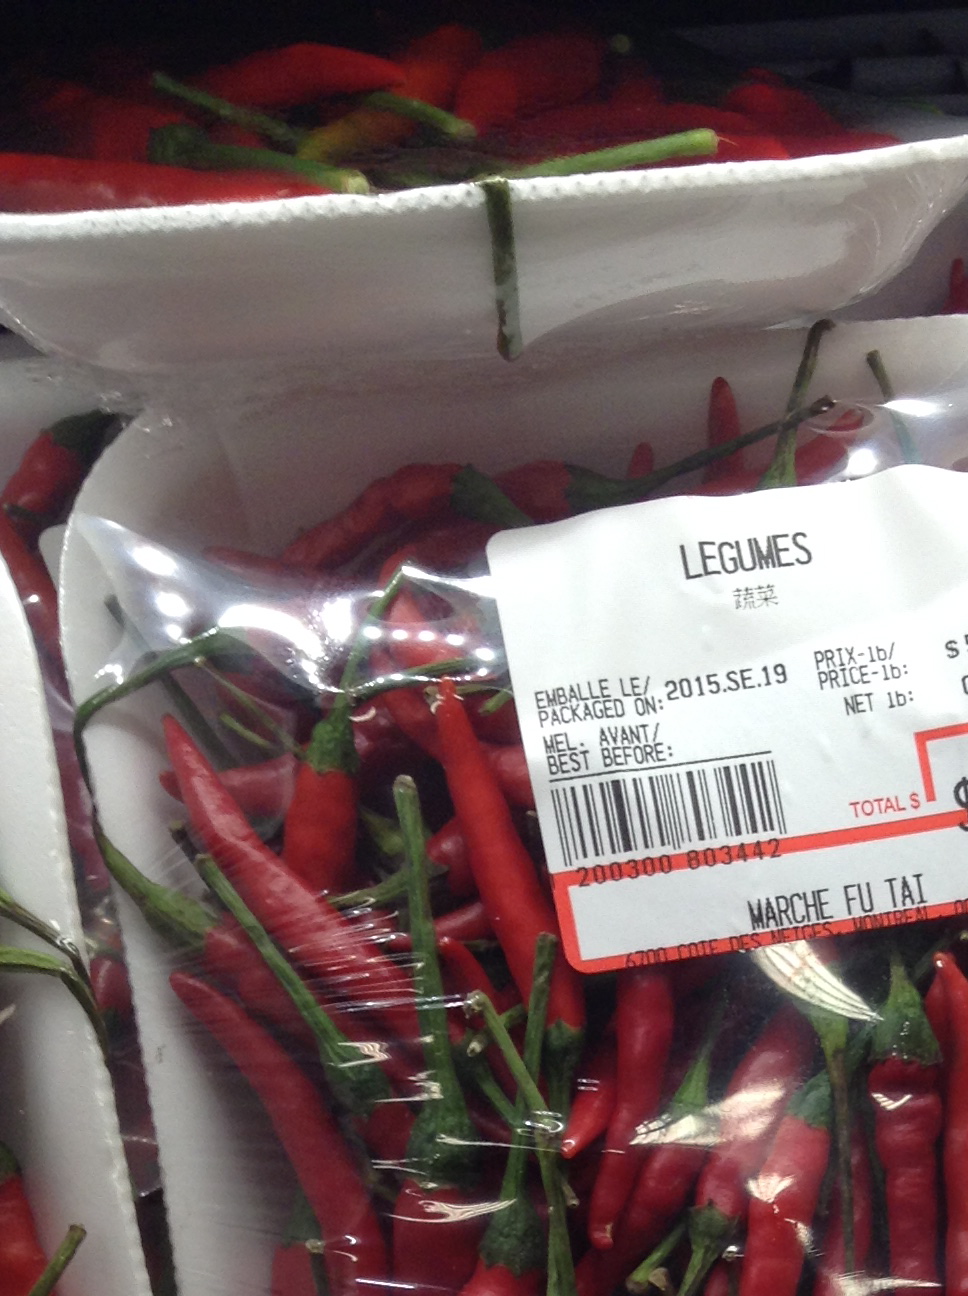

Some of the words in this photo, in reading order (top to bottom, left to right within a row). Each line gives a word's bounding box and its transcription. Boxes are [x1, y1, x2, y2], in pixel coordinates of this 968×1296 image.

[679, 532, 813, 580] LEGUMES
[732, 584, 779, 610] 蔬菜
[534, 678, 611, 710] EMBALLE
[619, 676, 650, 697] LE/
[664, 663, 788, 701] 2015.SE.19
[538, 698, 626, 728] PACKAGED
[634, 696, 664, 717] ON:
[844, 692, 874, 716] NET
[543, 732, 586, 754] MEL.
[599, 722, 660, 747] AVANT/
[546, 749, 590, 776] BEST
[602, 742, 674, 769] BEFORE:
[849, 796, 906, 818] TOTAL
[576, 854, 673, 888] 200300
[686, 838, 783, 871] 803442
[747, 888, 834, 931] MARCHE
[843, 882, 875, 915] FU
[884, 872, 928, 909] TAI
